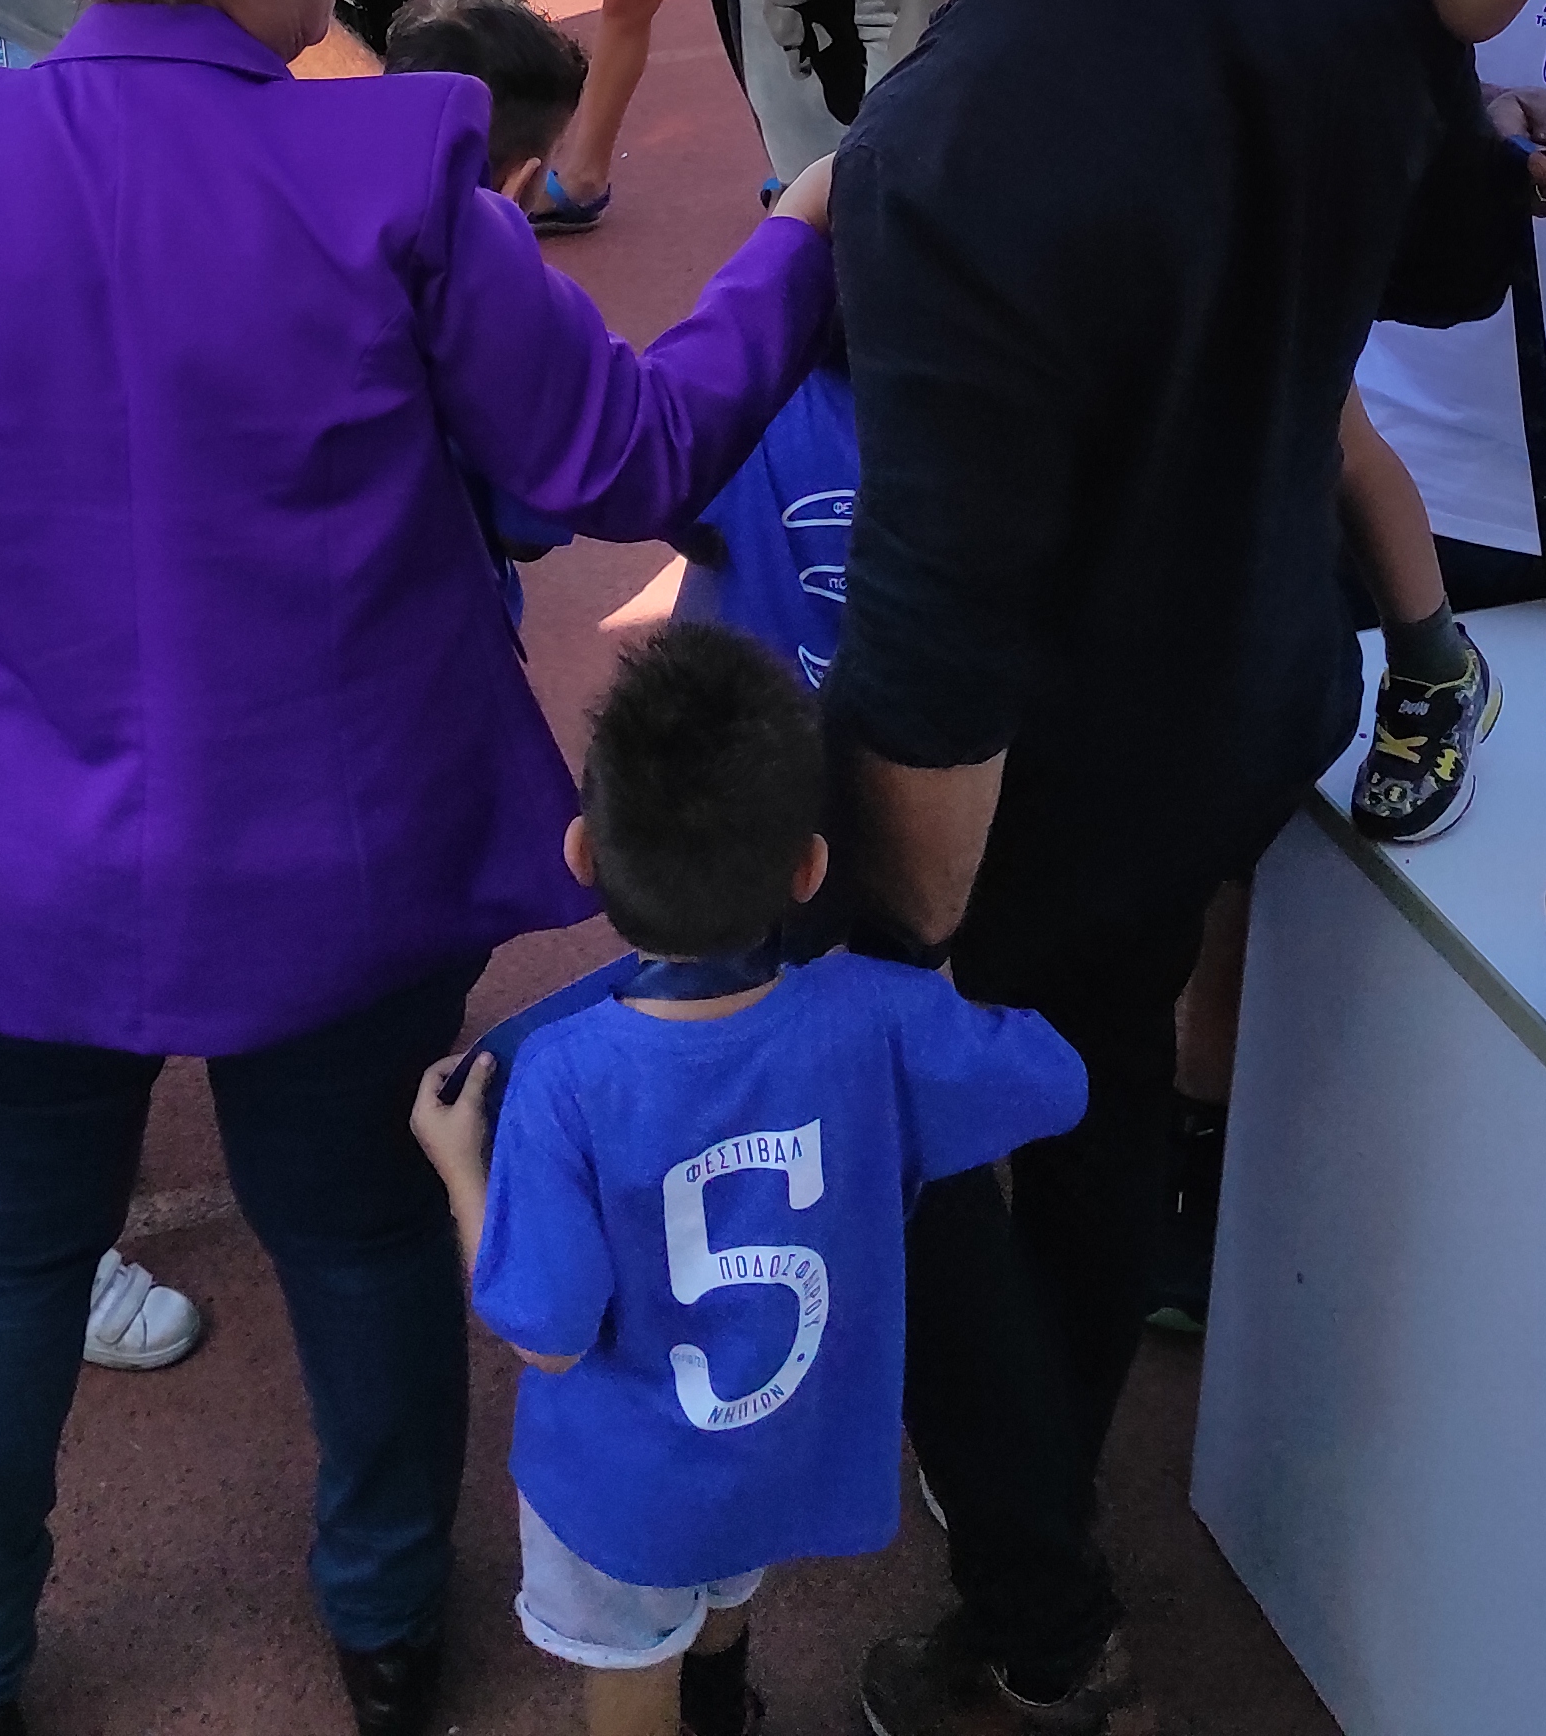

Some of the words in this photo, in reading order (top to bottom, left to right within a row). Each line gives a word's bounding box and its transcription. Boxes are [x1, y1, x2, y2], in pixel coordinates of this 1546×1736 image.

[684, 1136, 803, 1184] ΦΕΣΤΙΒΑΛ
[661, 1117, 831, 1432] 5
[706, 1382, 786, 1425] ΝΗΠΙΩΝ
